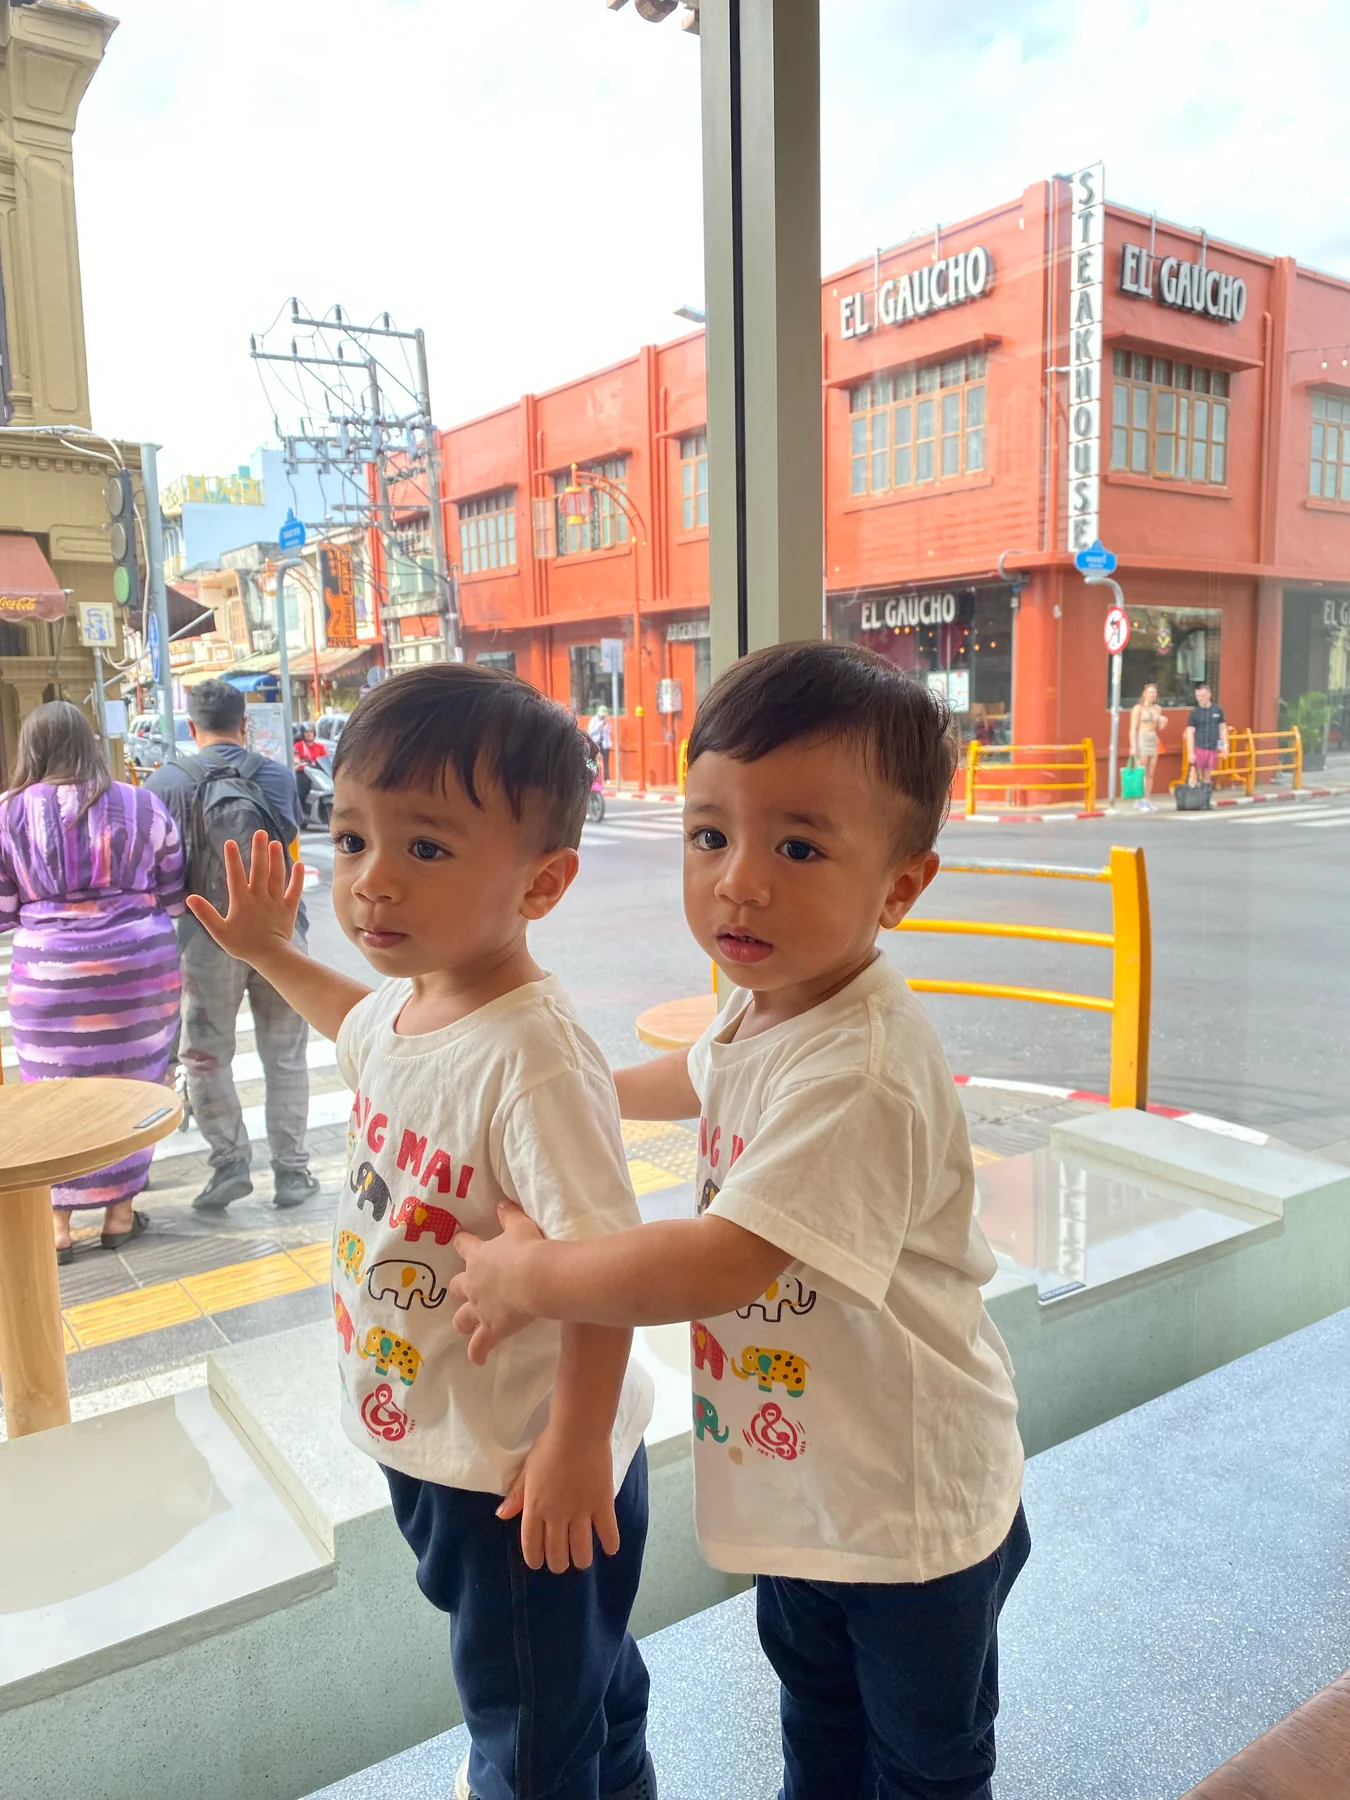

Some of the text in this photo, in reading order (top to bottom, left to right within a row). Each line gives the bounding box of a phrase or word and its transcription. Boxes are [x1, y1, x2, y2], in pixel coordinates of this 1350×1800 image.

[840, 246, 988, 339] EL GAUCHO
[1121, 243, 1247, 323] EL GAUCHO
[1073, 170, 1095, 549] STEAKHOUSE
[861, 593, 955, 630] EL GAUCHO
[1324, 599, 1338, 625] EL
[396, 1128, 475, 1199] MAI
